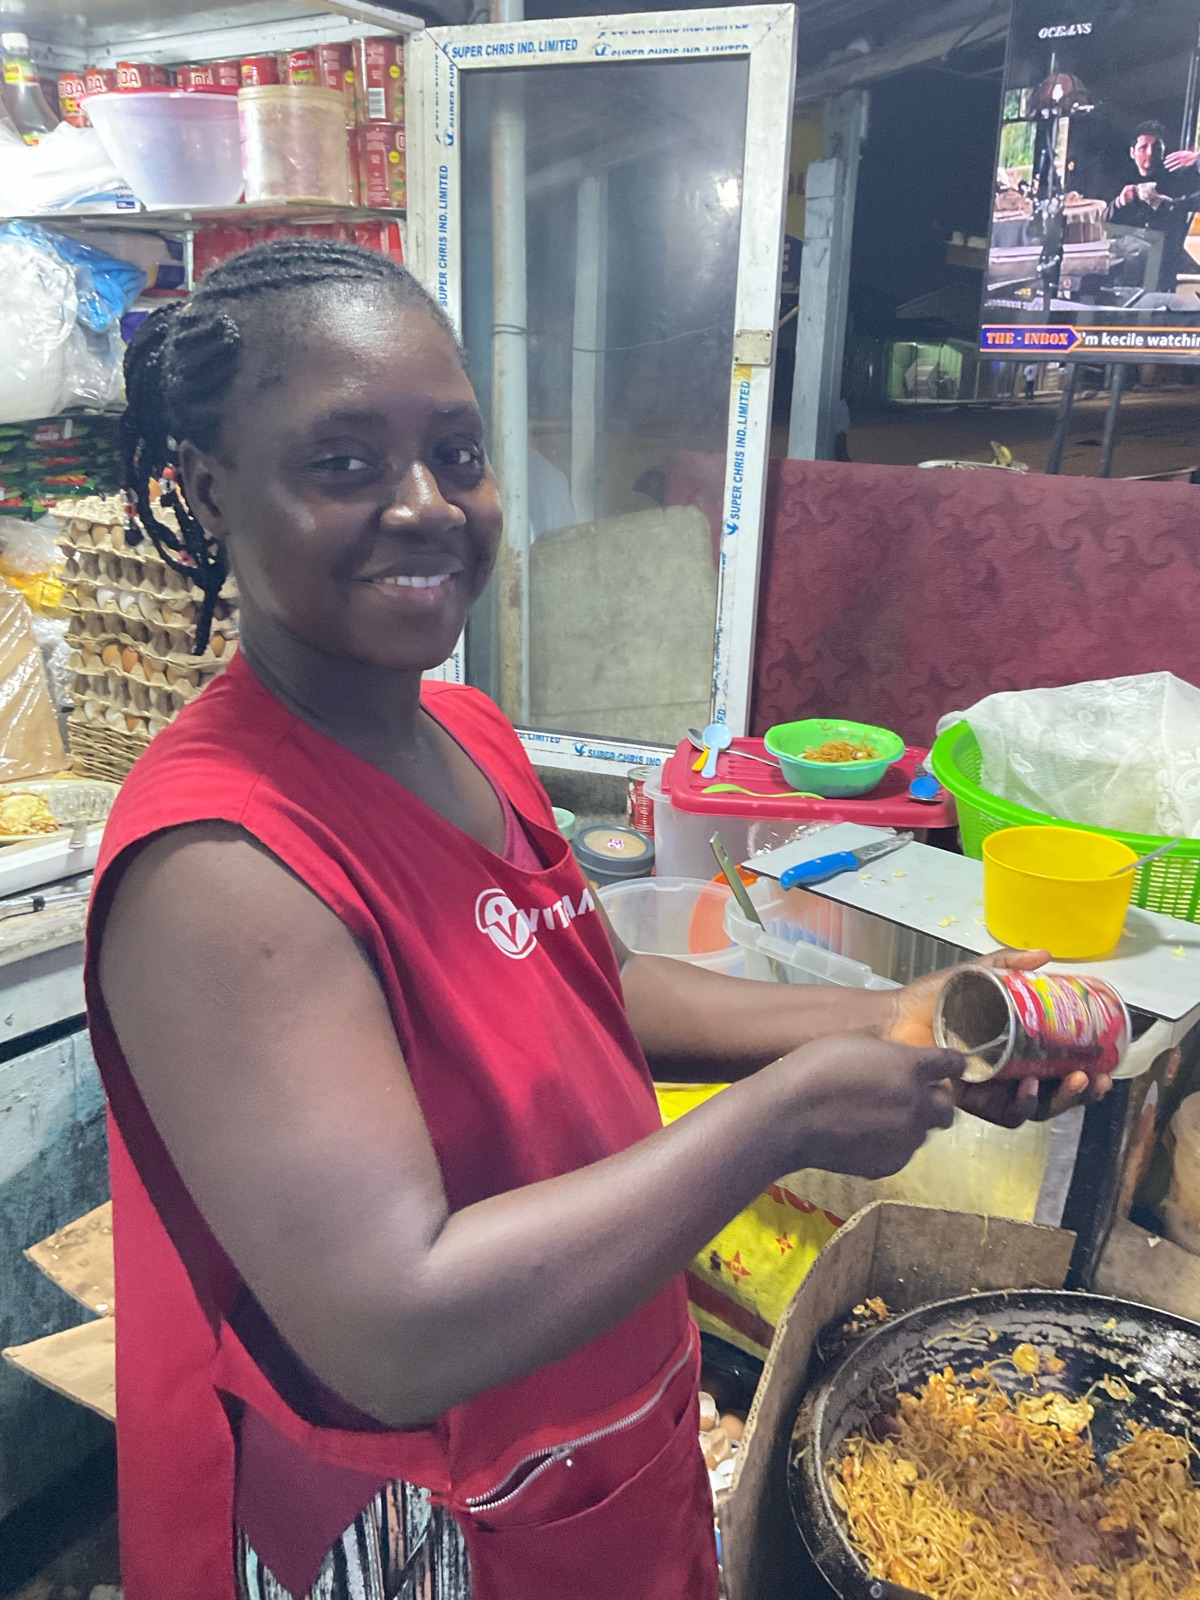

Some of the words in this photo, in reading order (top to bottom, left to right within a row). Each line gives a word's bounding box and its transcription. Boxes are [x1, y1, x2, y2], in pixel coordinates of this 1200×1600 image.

[1038, 22, 1092, 39] OCEANS
[452, 45, 483, 59] SUPER
[486, 43, 515, 56] CHRIS
[517, 42, 536, 54] IND.
[539, 39, 578, 53] LIMITED
[439, 165, 449, 210] LIMITED
[438, 212, 448, 233] IND.
[438, 236, 448, 269] CHRIS
[438, 271, 448, 307] SUPER
[986, 331, 1015, 345] THE
[1024, 332, 1069, 346] INBOX
[1101, 331, 1144, 347] kecile
[738, 381, 751, 426] LIMITED
[735, 426, 747, 449] IND.
[733, 451, 745, 484] CHRIS
[730, 485, 742, 520] SUPER
